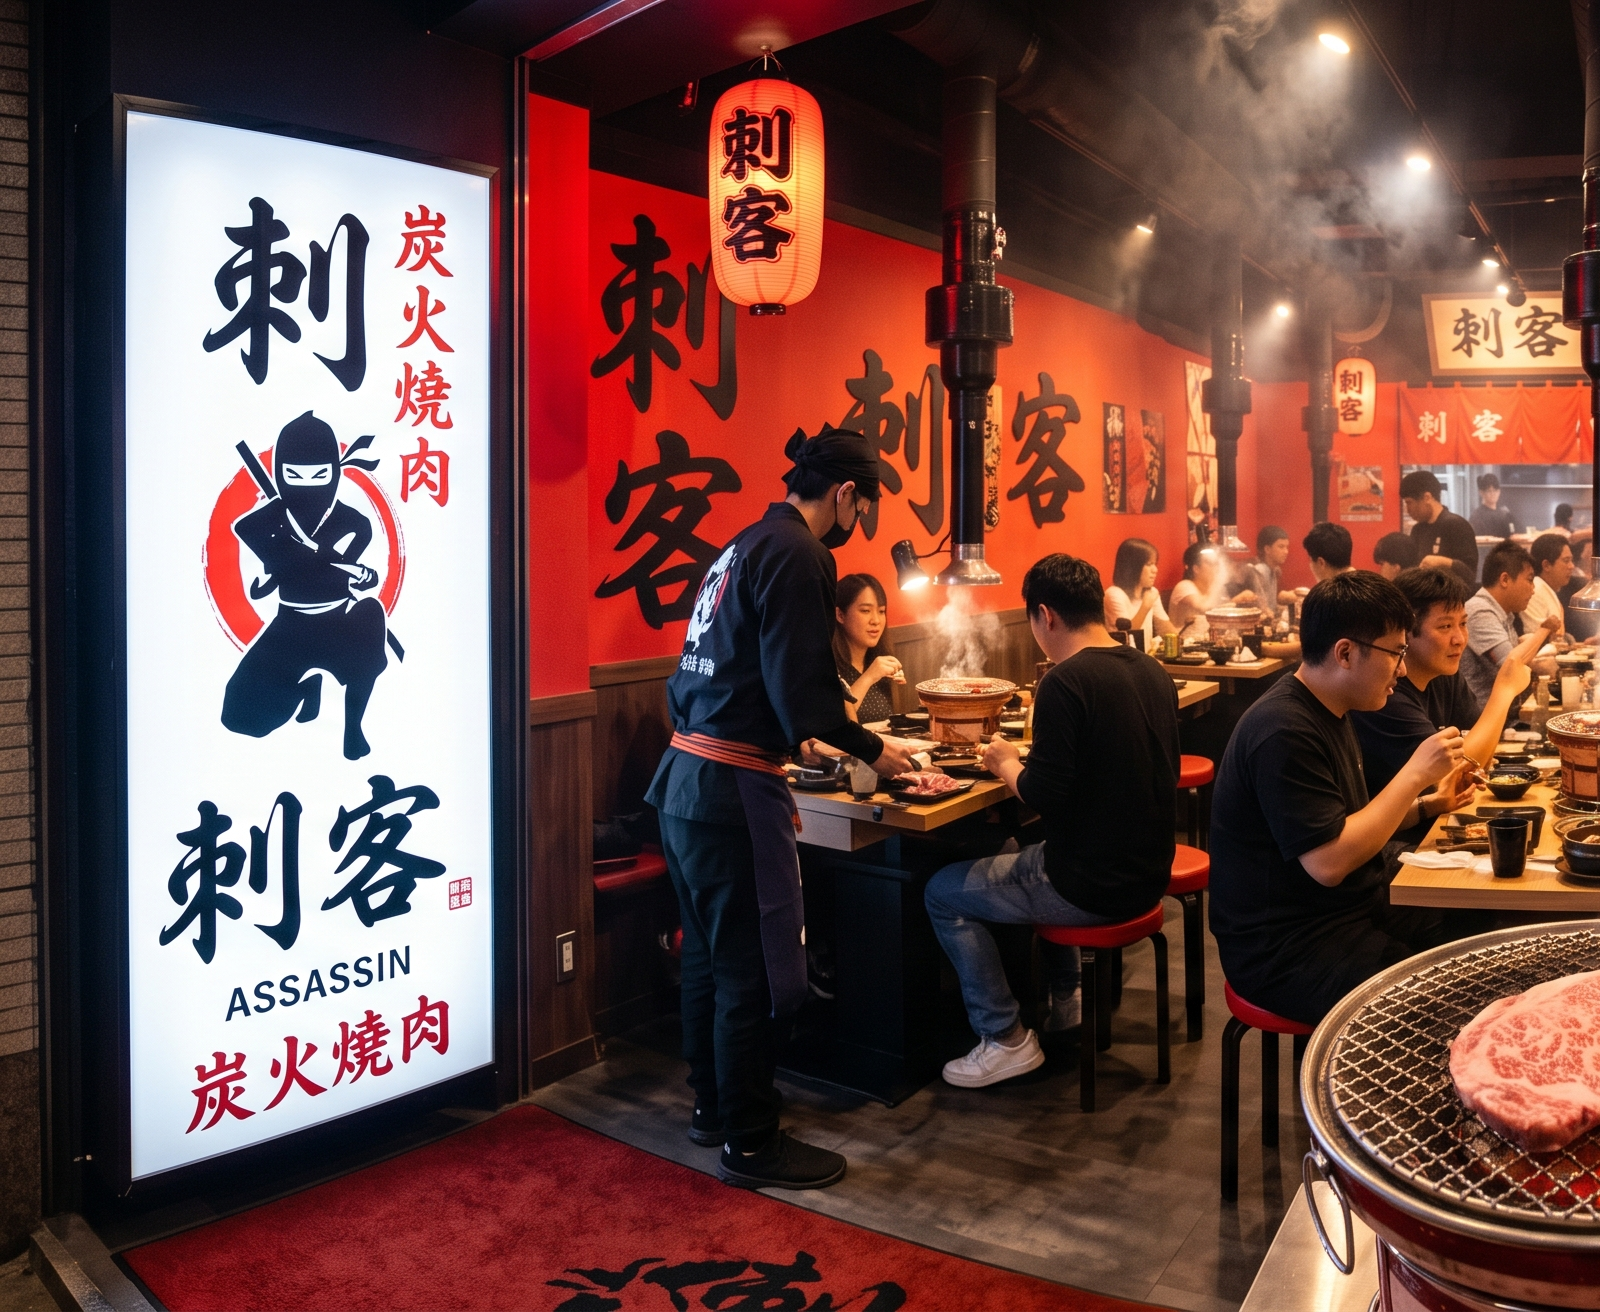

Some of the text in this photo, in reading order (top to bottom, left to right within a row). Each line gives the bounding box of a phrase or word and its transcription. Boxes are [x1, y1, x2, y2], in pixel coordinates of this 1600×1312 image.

[721, 106, 795, 263] 刺客
[203, 196, 370, 392] 刺
[394, 204, 455, 507] 炭火燒肉
[1340, 369, 1363, 422] 刺客
[159, 774, 446, 965] 刺客
[225, 945, 411, 1022] ASSASSIN
[185, 994, 450, 1134] 炭火燒肉
